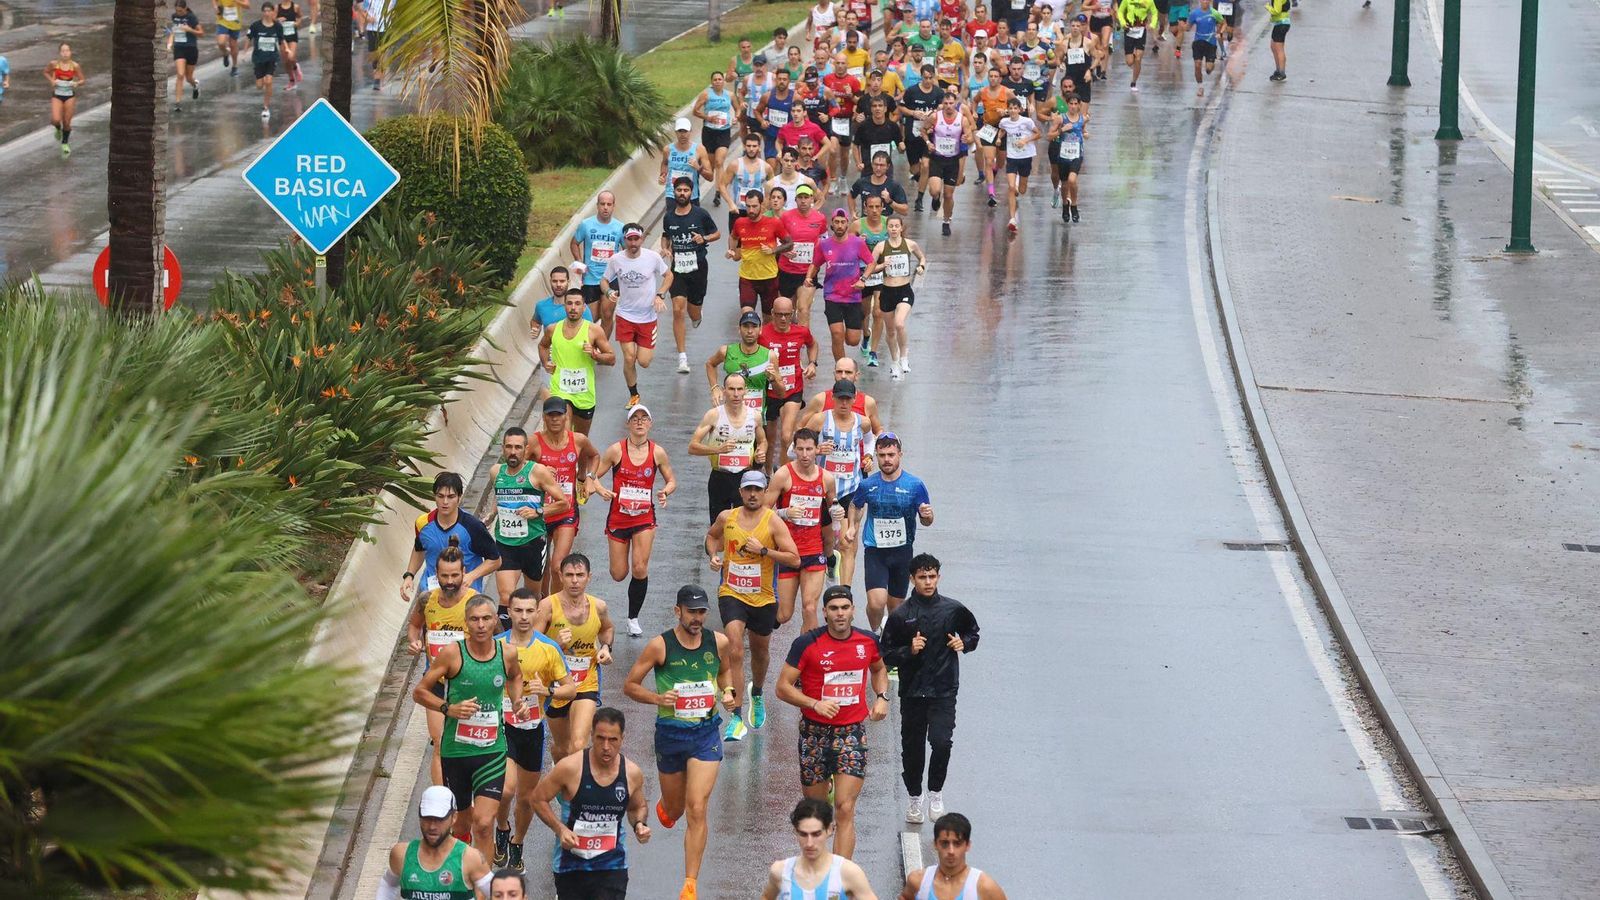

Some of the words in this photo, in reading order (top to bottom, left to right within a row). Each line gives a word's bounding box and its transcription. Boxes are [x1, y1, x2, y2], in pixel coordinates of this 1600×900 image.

[297, 155, 346, 173] RED
[275, 178, 367, 197] BASICA
[562, 377, 586, 387] 11479
[629, 501, 641, 510] 17
[879, 530, 902, 539] 1375
[735, 577, 753, 587] 105
[833, 686, 854, 697] 113
[684, 697, 706, 709] 236
[468, 727, 489, 739] 146
[586, 839, 602, 849] 98
